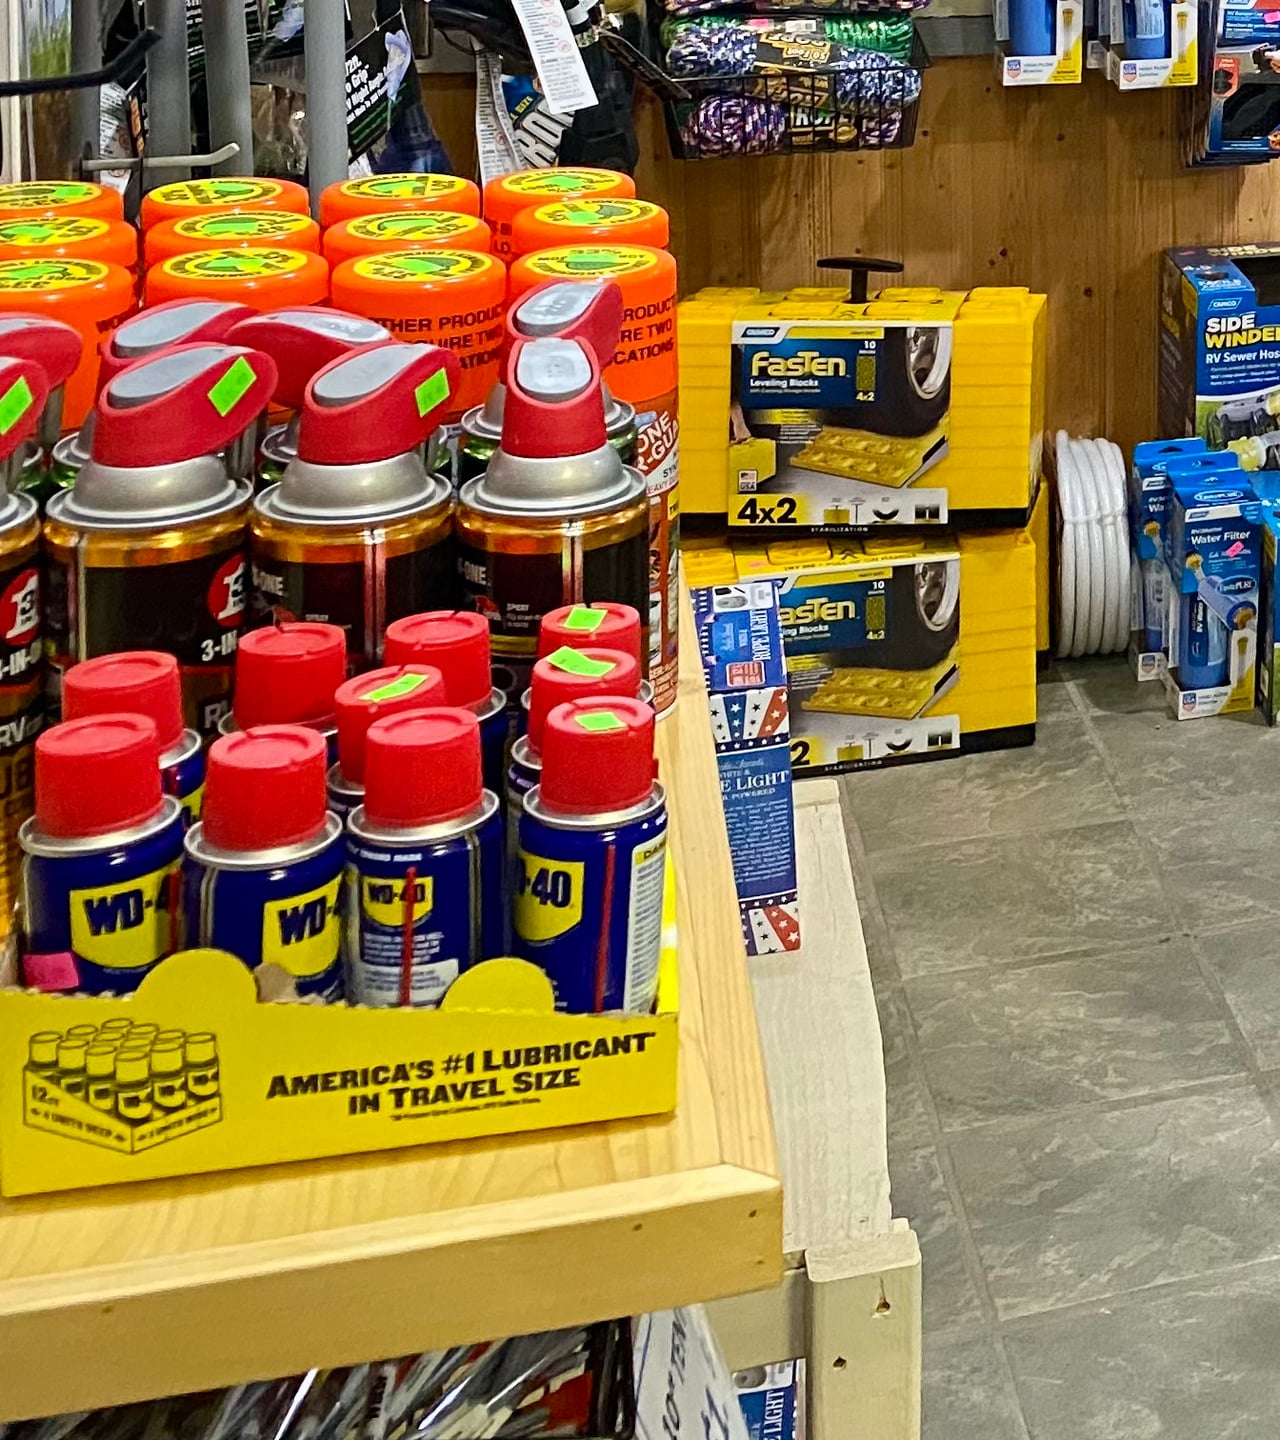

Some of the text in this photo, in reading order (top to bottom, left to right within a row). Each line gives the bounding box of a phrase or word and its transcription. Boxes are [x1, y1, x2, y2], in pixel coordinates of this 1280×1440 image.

[1206, 313, 1256, 333] SIDE
[751, 351, 846, 377] FasTen
[1206, 352, 1222, 364] RV
[1223, 351, 1257, 363] Sewer
[750, 379, 819, 388] Leveling Blocks
[737, 497, 798, 524] 4x2
[1190, 529, 1251, 545] Water Filter
[266, 1032, 650, 1099] AMERICA'S LUBRICANT
[348, 1066, 581, 1116] IN TRAVEL SIZE
